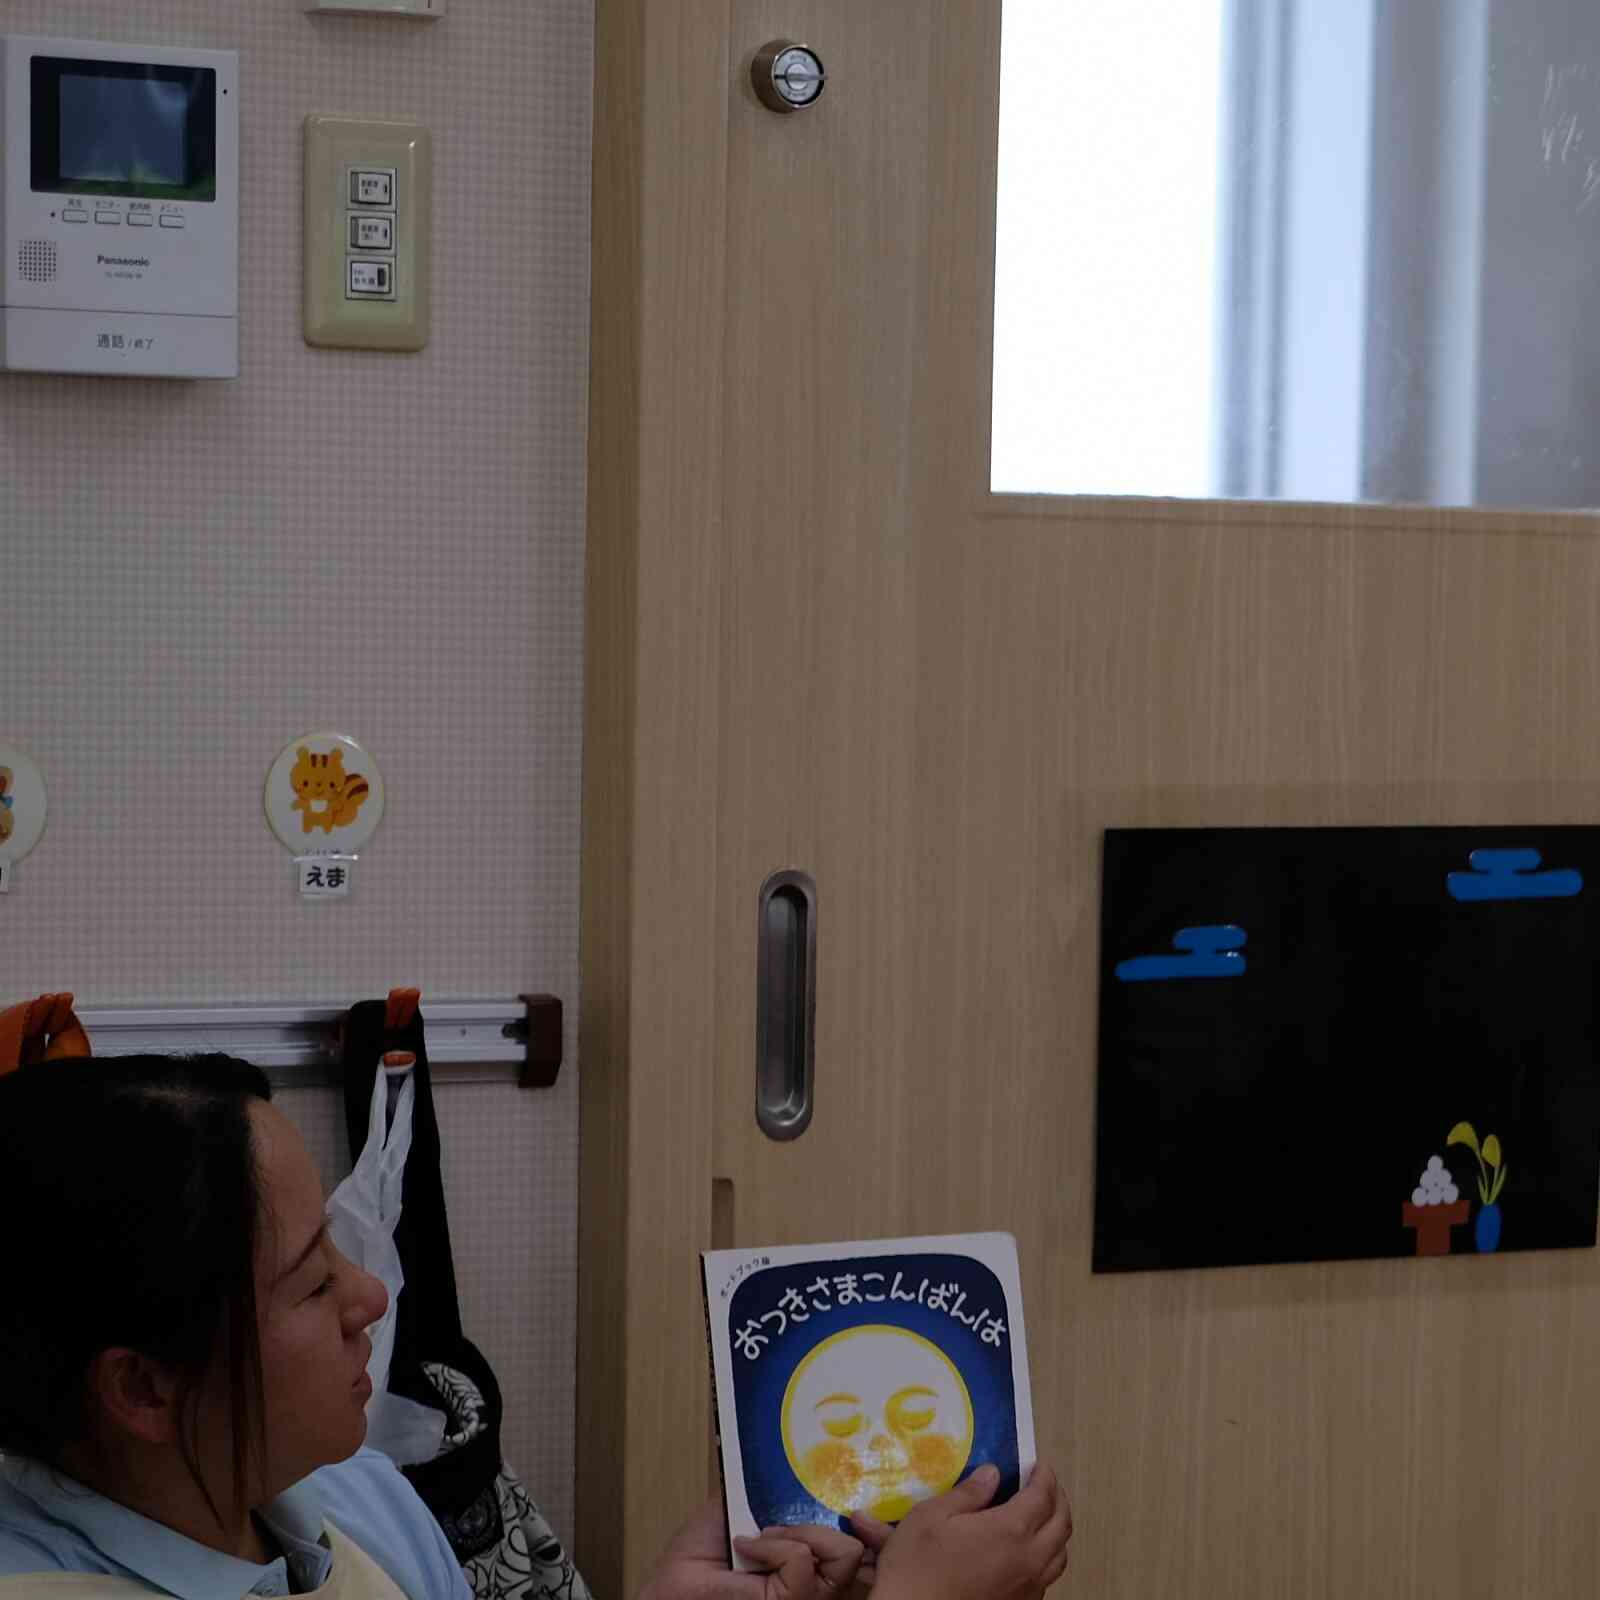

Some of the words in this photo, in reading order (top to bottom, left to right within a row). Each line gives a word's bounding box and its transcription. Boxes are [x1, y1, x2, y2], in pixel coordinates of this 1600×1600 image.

[97, 255, 150, 266] Panasonic
[306, 865, 345, 888] えま
[733, 1271, 1008, 1361] おつきさまこんばんは
